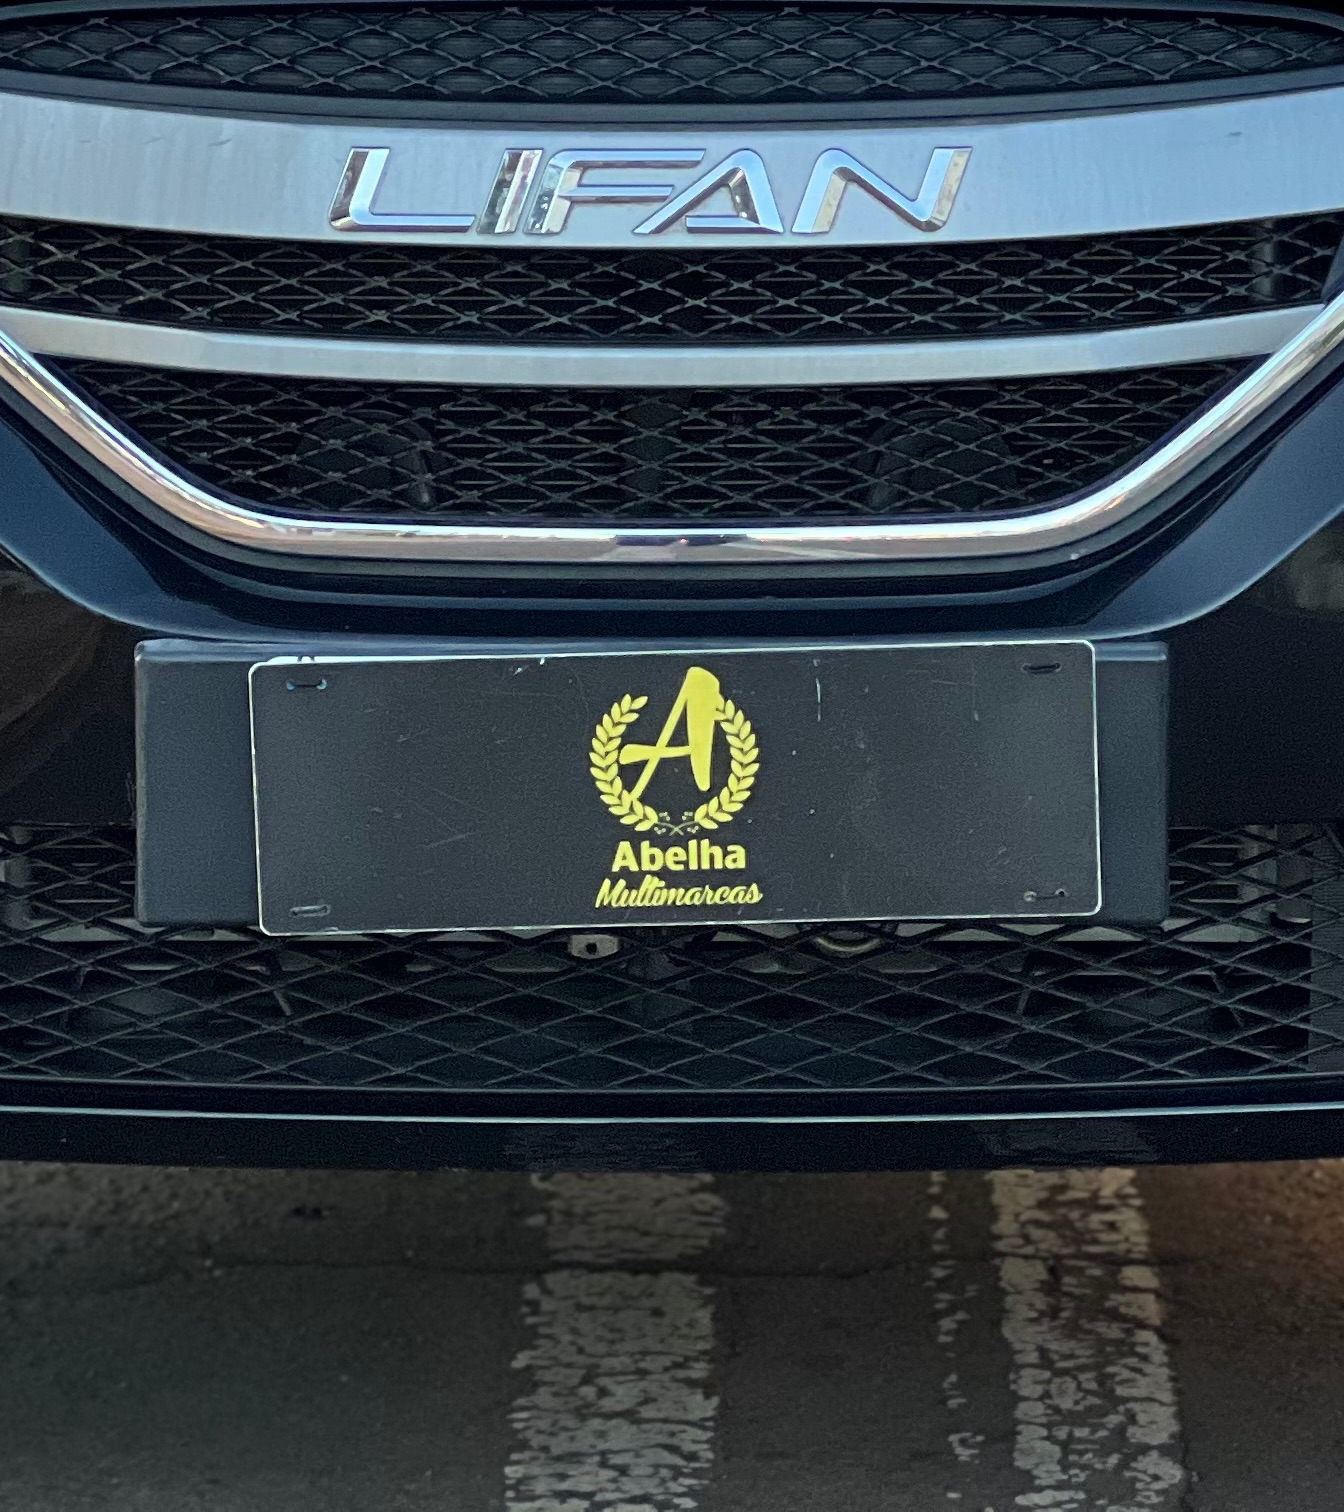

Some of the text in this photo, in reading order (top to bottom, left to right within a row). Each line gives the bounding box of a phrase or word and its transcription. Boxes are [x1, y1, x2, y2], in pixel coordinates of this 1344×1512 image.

[328, 146, 973, 234] LIFAN
[619, 666, 720, 801] A
[612, 839, 746, 872] Abelha
[594, 874, 763, 909] Multimarcas
